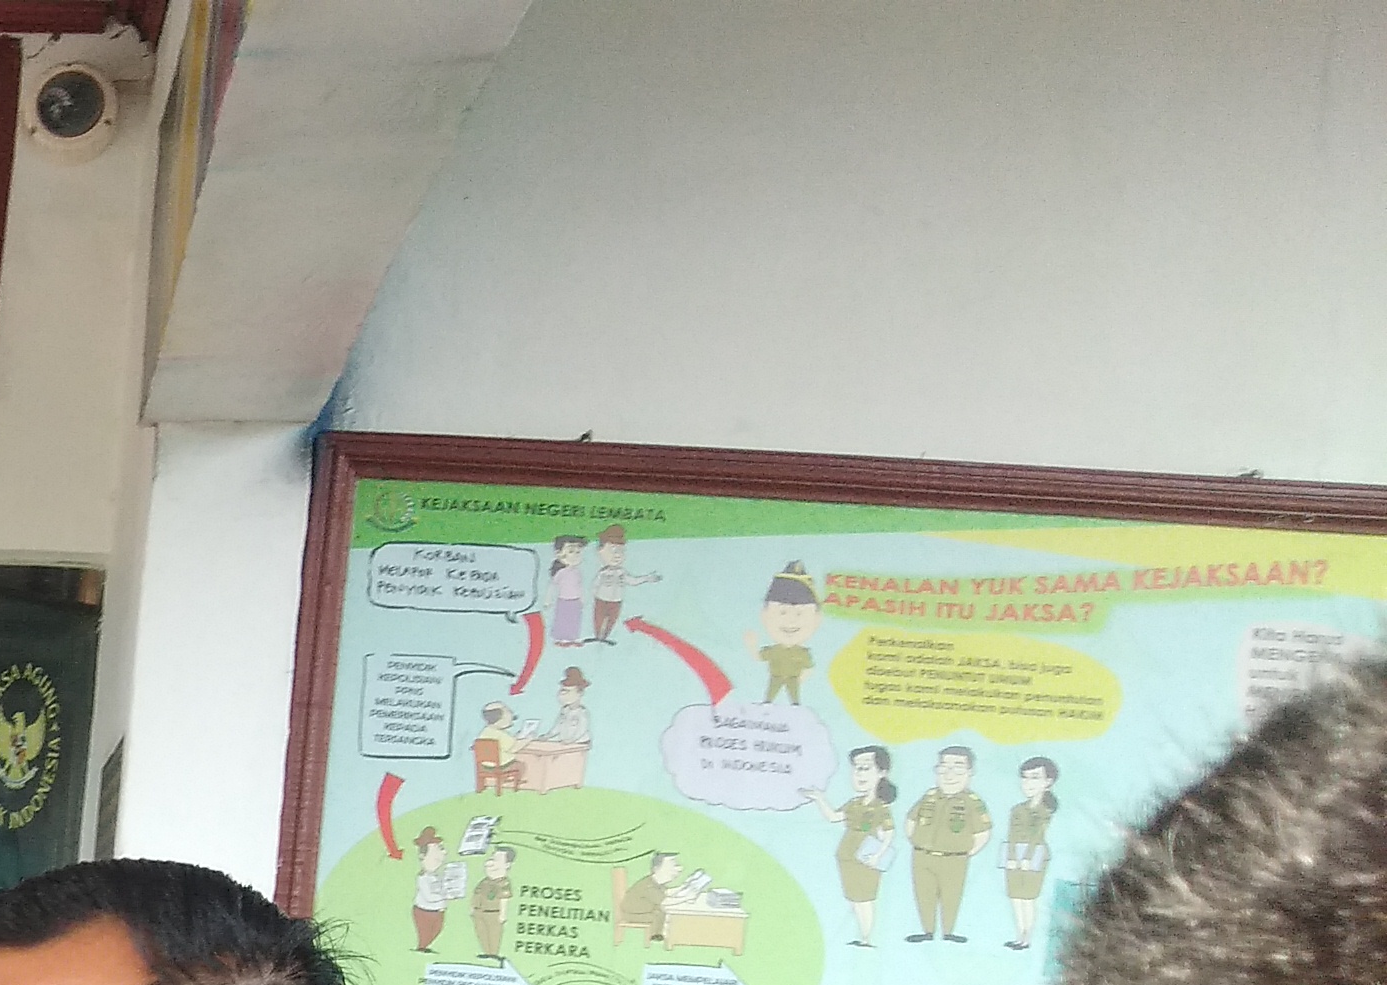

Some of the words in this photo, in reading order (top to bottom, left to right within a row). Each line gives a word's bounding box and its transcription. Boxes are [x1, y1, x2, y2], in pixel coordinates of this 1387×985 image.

[420, 497, 518, 515] KEJAKSAAN
[525, 503, 586, 518] NEGERI
[591, 505, 666, 522] LEMBATA
[826, 574, 960, 595] KENALAN
[971, 577, 1026, 596] YUK
[1035, 571, 1121, 594] SAMA
[1132, 559, 1328, 591] KEJAKSAAN?
[824, 593, 926, 617] APASIH
[936, 602, 975, 620] ITU
[985, 602, 1095, 623] JAKSA?
[519, 885, 583, 902] PROSES
[517, 903, 611, 924] PENELITIAN
[516, 922, 579, 940] BERKAS
[514, 941, 591, 959] PERKARA
